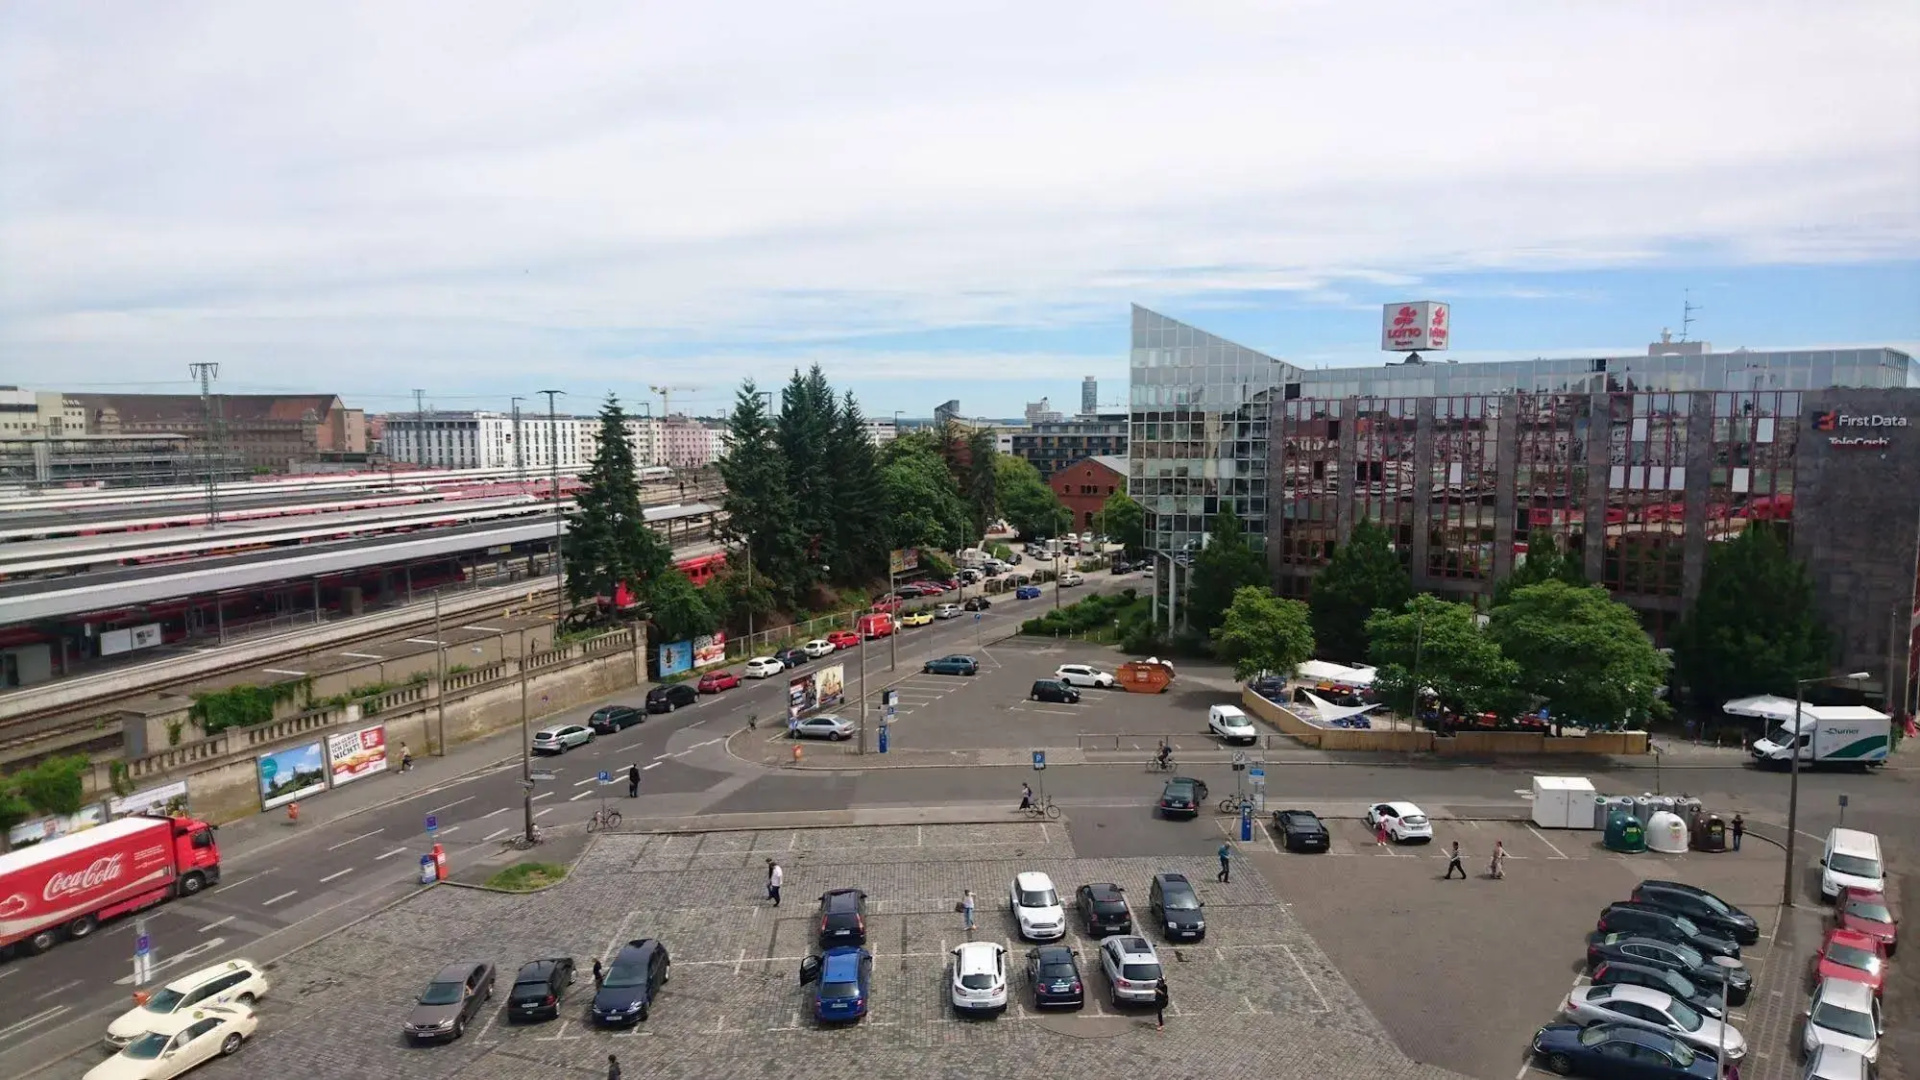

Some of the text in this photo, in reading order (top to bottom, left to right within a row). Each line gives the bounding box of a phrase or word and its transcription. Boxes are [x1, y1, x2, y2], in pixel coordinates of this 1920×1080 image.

[1387, 327, 1422, 339] LOTTO
[1839, 414, 1907, 427] First Data
